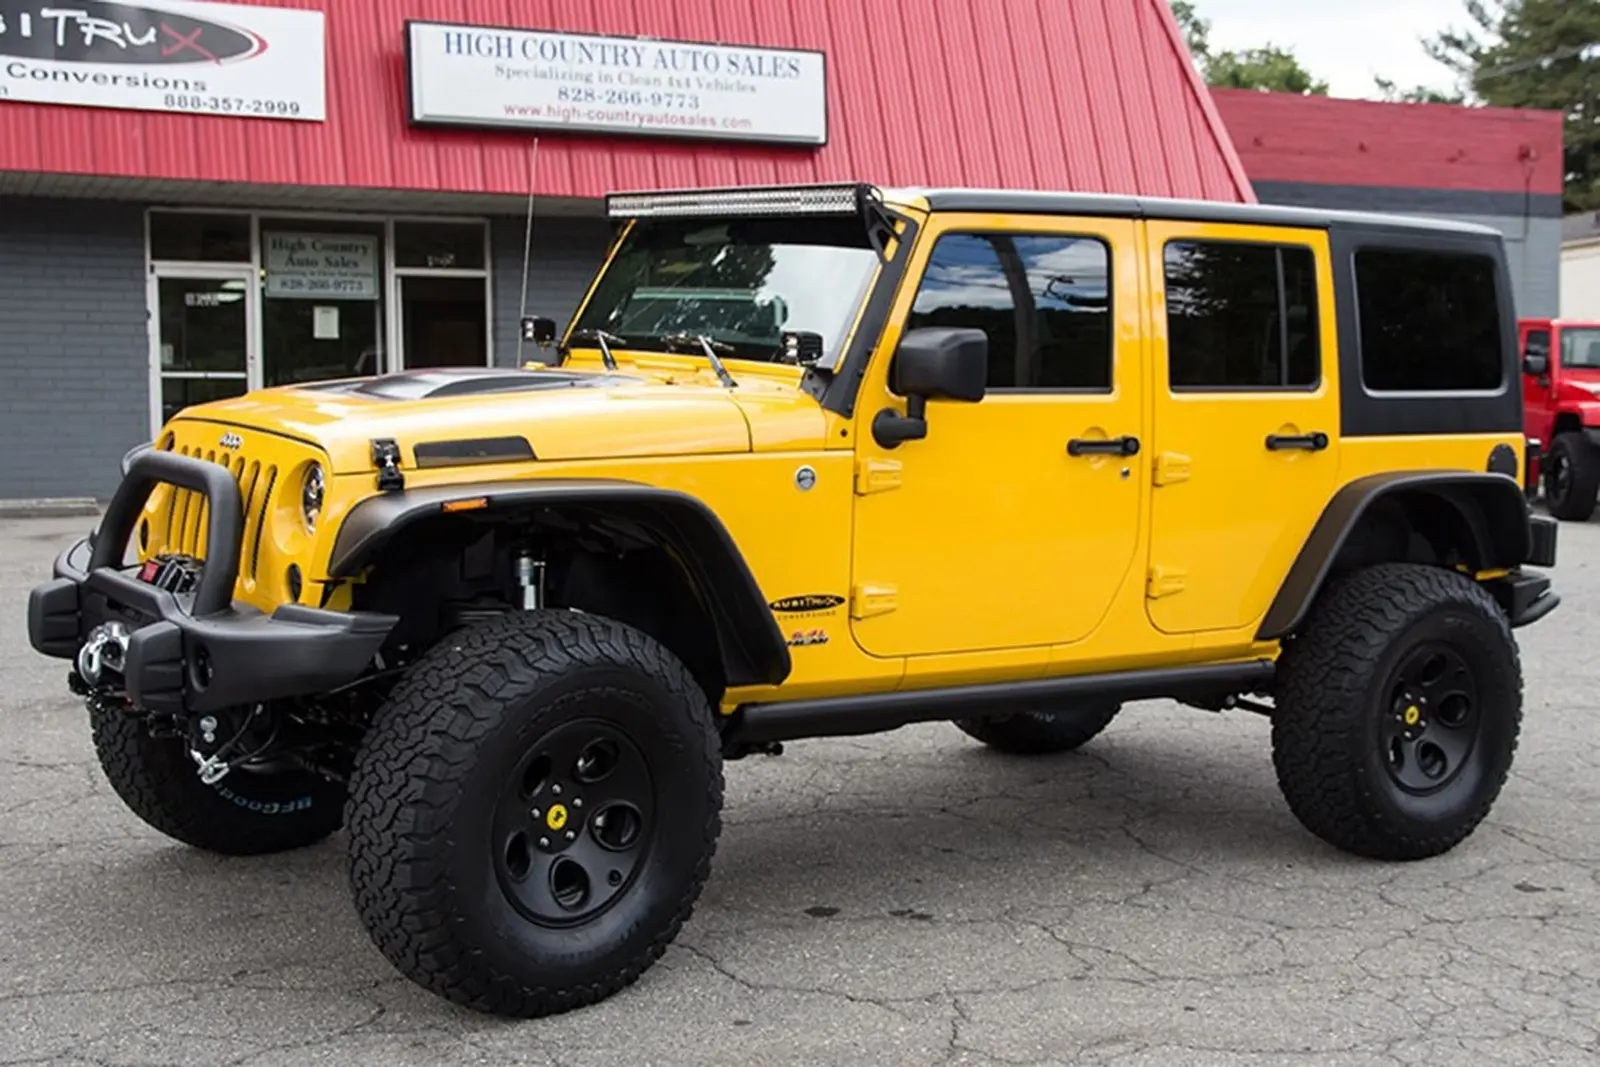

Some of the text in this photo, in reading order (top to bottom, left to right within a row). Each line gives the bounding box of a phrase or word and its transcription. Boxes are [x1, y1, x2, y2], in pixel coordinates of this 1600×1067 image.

[0, 8, 222, 65] ITRUX
[444, 32, 800, 79] HIGH COUNTRY AUTO SALES
[6, 62, 206, 92] Conversions
[495, 64, 757, 94] Specializing in Clean 4x4 Vehicles
[163, 94, 301, 114] 888-357-2999
[557, 87, 700, 109] 828-266-9773
[503, 104, 753, 128] www.high-countryautosales.com
[271, 237, 368, 256] High Country
[285, 254, 359, 268] Auto Sales
